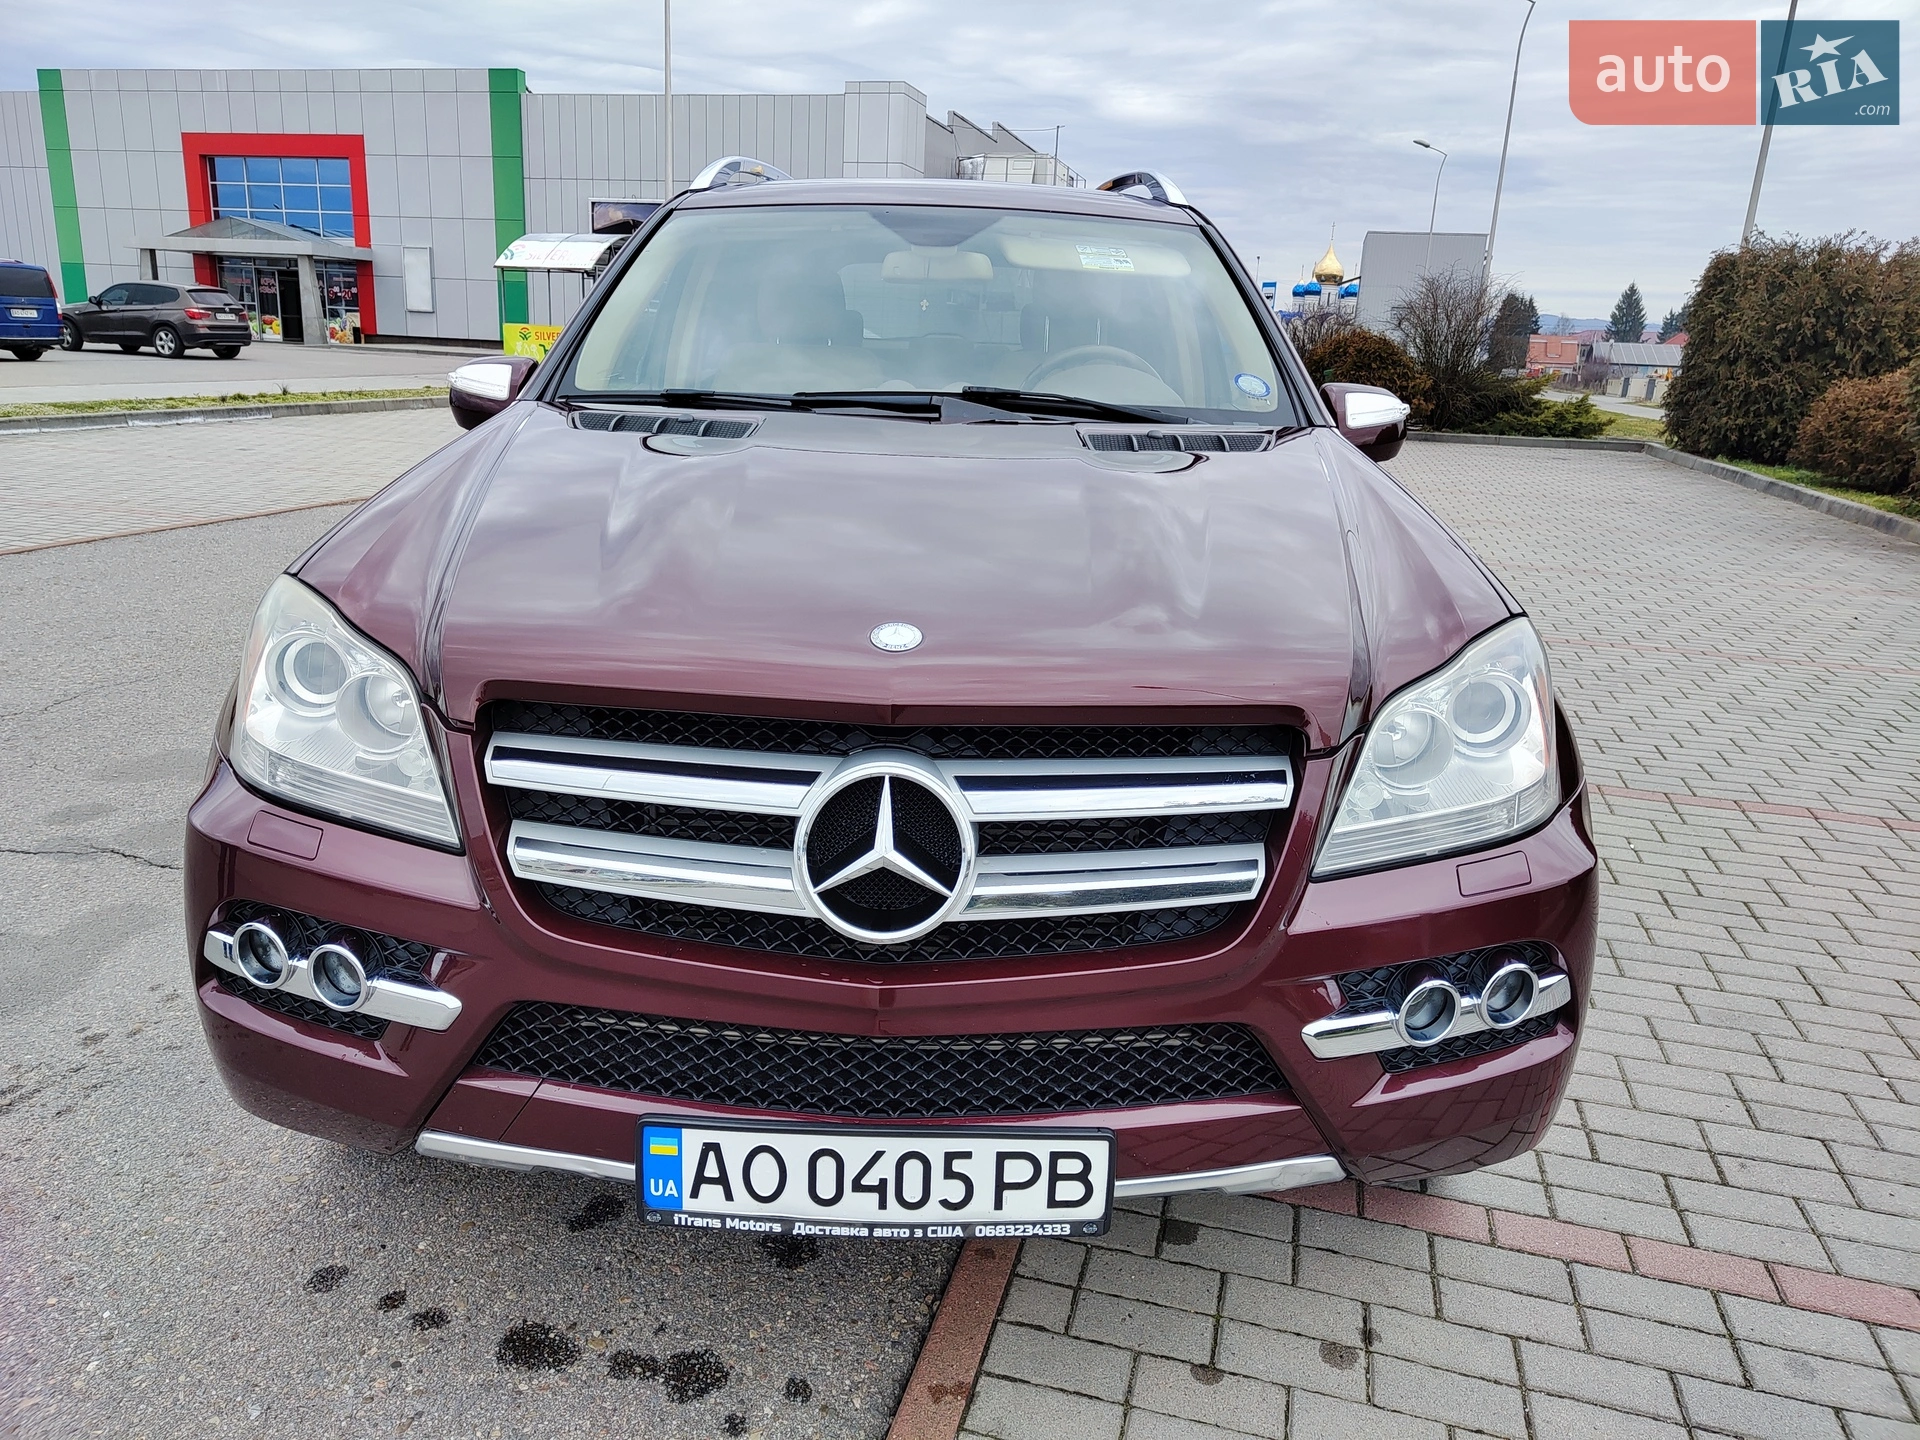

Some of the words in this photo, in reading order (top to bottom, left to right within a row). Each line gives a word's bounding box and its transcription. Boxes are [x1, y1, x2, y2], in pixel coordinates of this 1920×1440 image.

[649, 1178, 679, 1198] UA
[689, 1142, 787, 1204] AO
[807, 1147, 975, 1211] 0405
[993, 1150, 1094, 1211] PB
[673, 1213, 722, 1229] iTrans
[725, 1217, 782, 1233] Motors
[792, 1221, 869, 1237] Доставка
[872, 1227, 910, 1238] авто
[913, 1228, 924, 1238] з
[927, 1226, 964, 1238] США
[974, 1223, 1071, 1237] 0683234333
